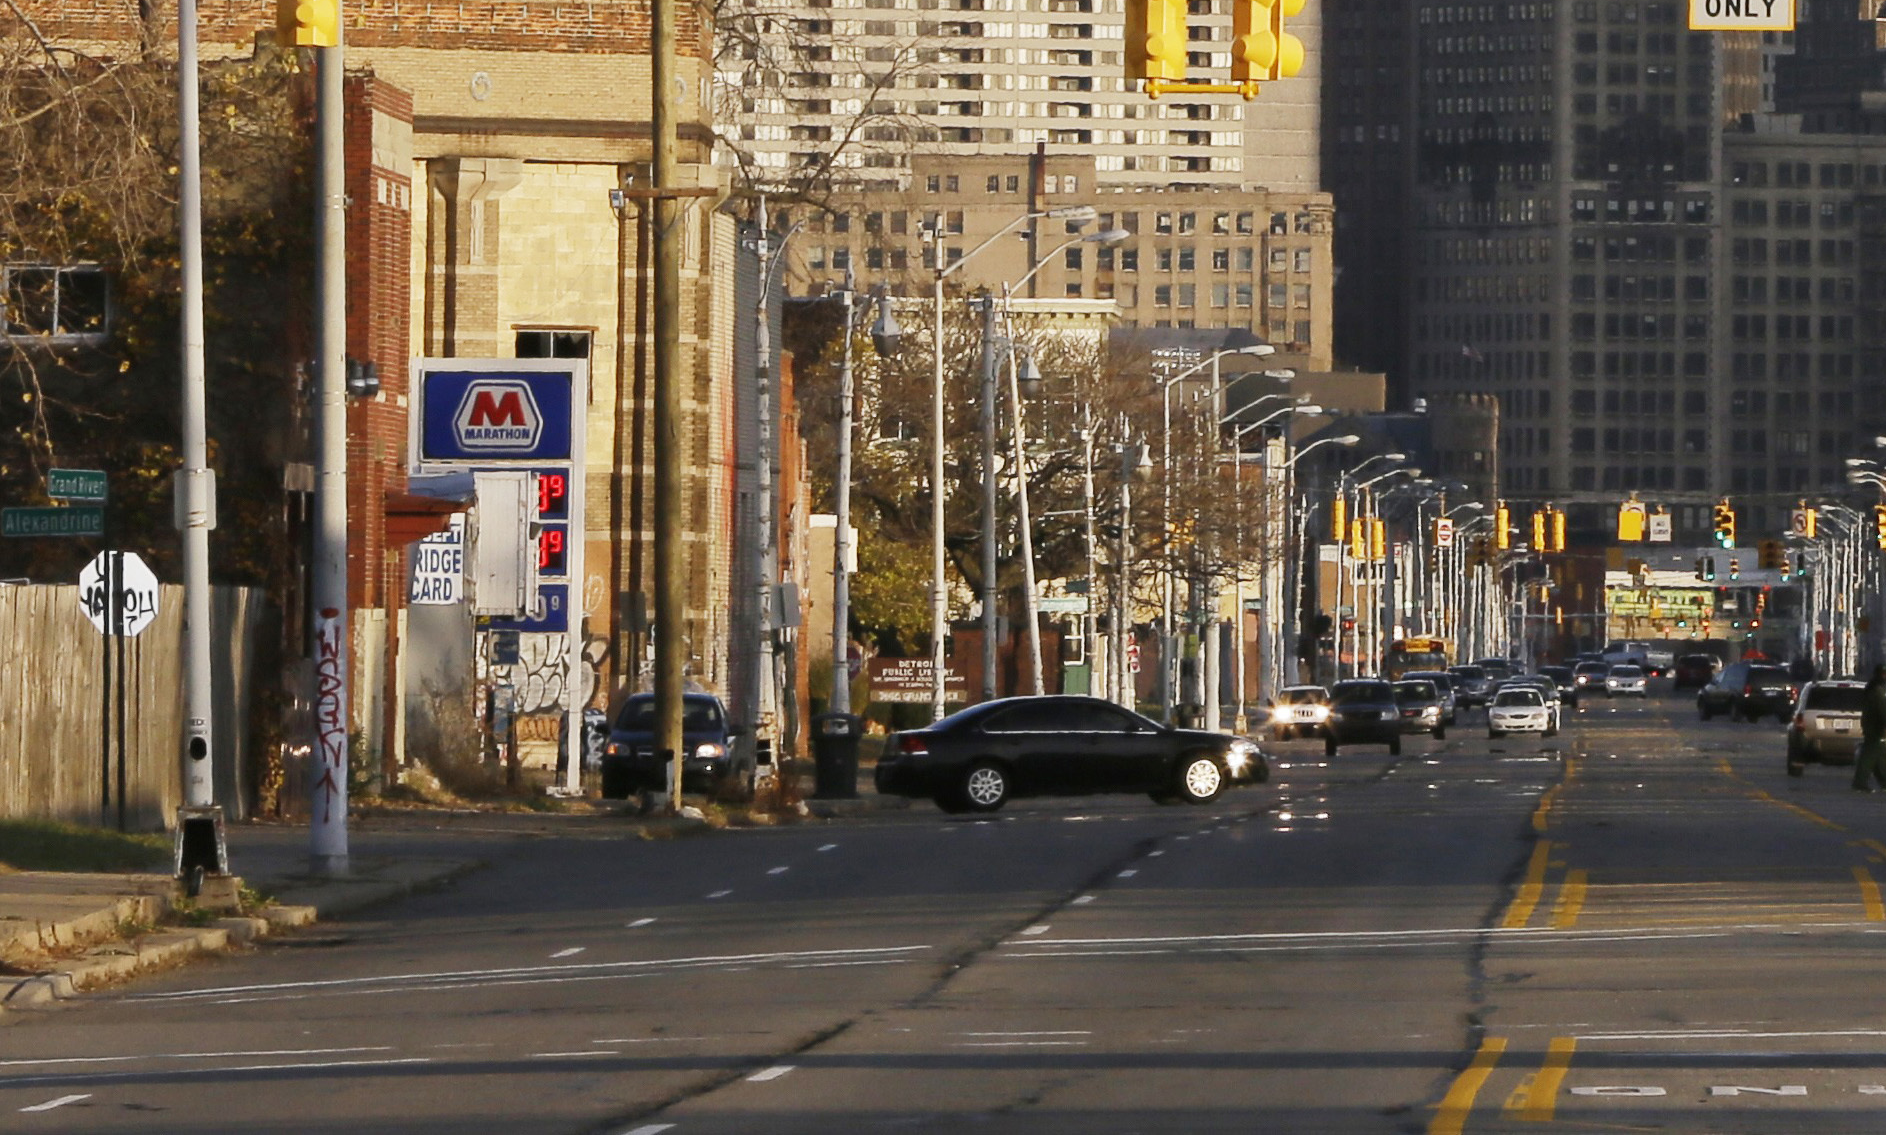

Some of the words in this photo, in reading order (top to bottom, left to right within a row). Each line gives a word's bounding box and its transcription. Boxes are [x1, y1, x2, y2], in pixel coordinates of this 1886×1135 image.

[468, 391, 527, 426] M
[464, 428, 531, 440] MARATHON
[51, 475, 77, 494] Grand
[79, 476, 104, 495] River
[5, 513, 101, 532] Alexandrine
[416, 549, 461, 574] RIDGE
[412, 577, 452, 601] CARD
[899, 660, 933, 668] DETROI
